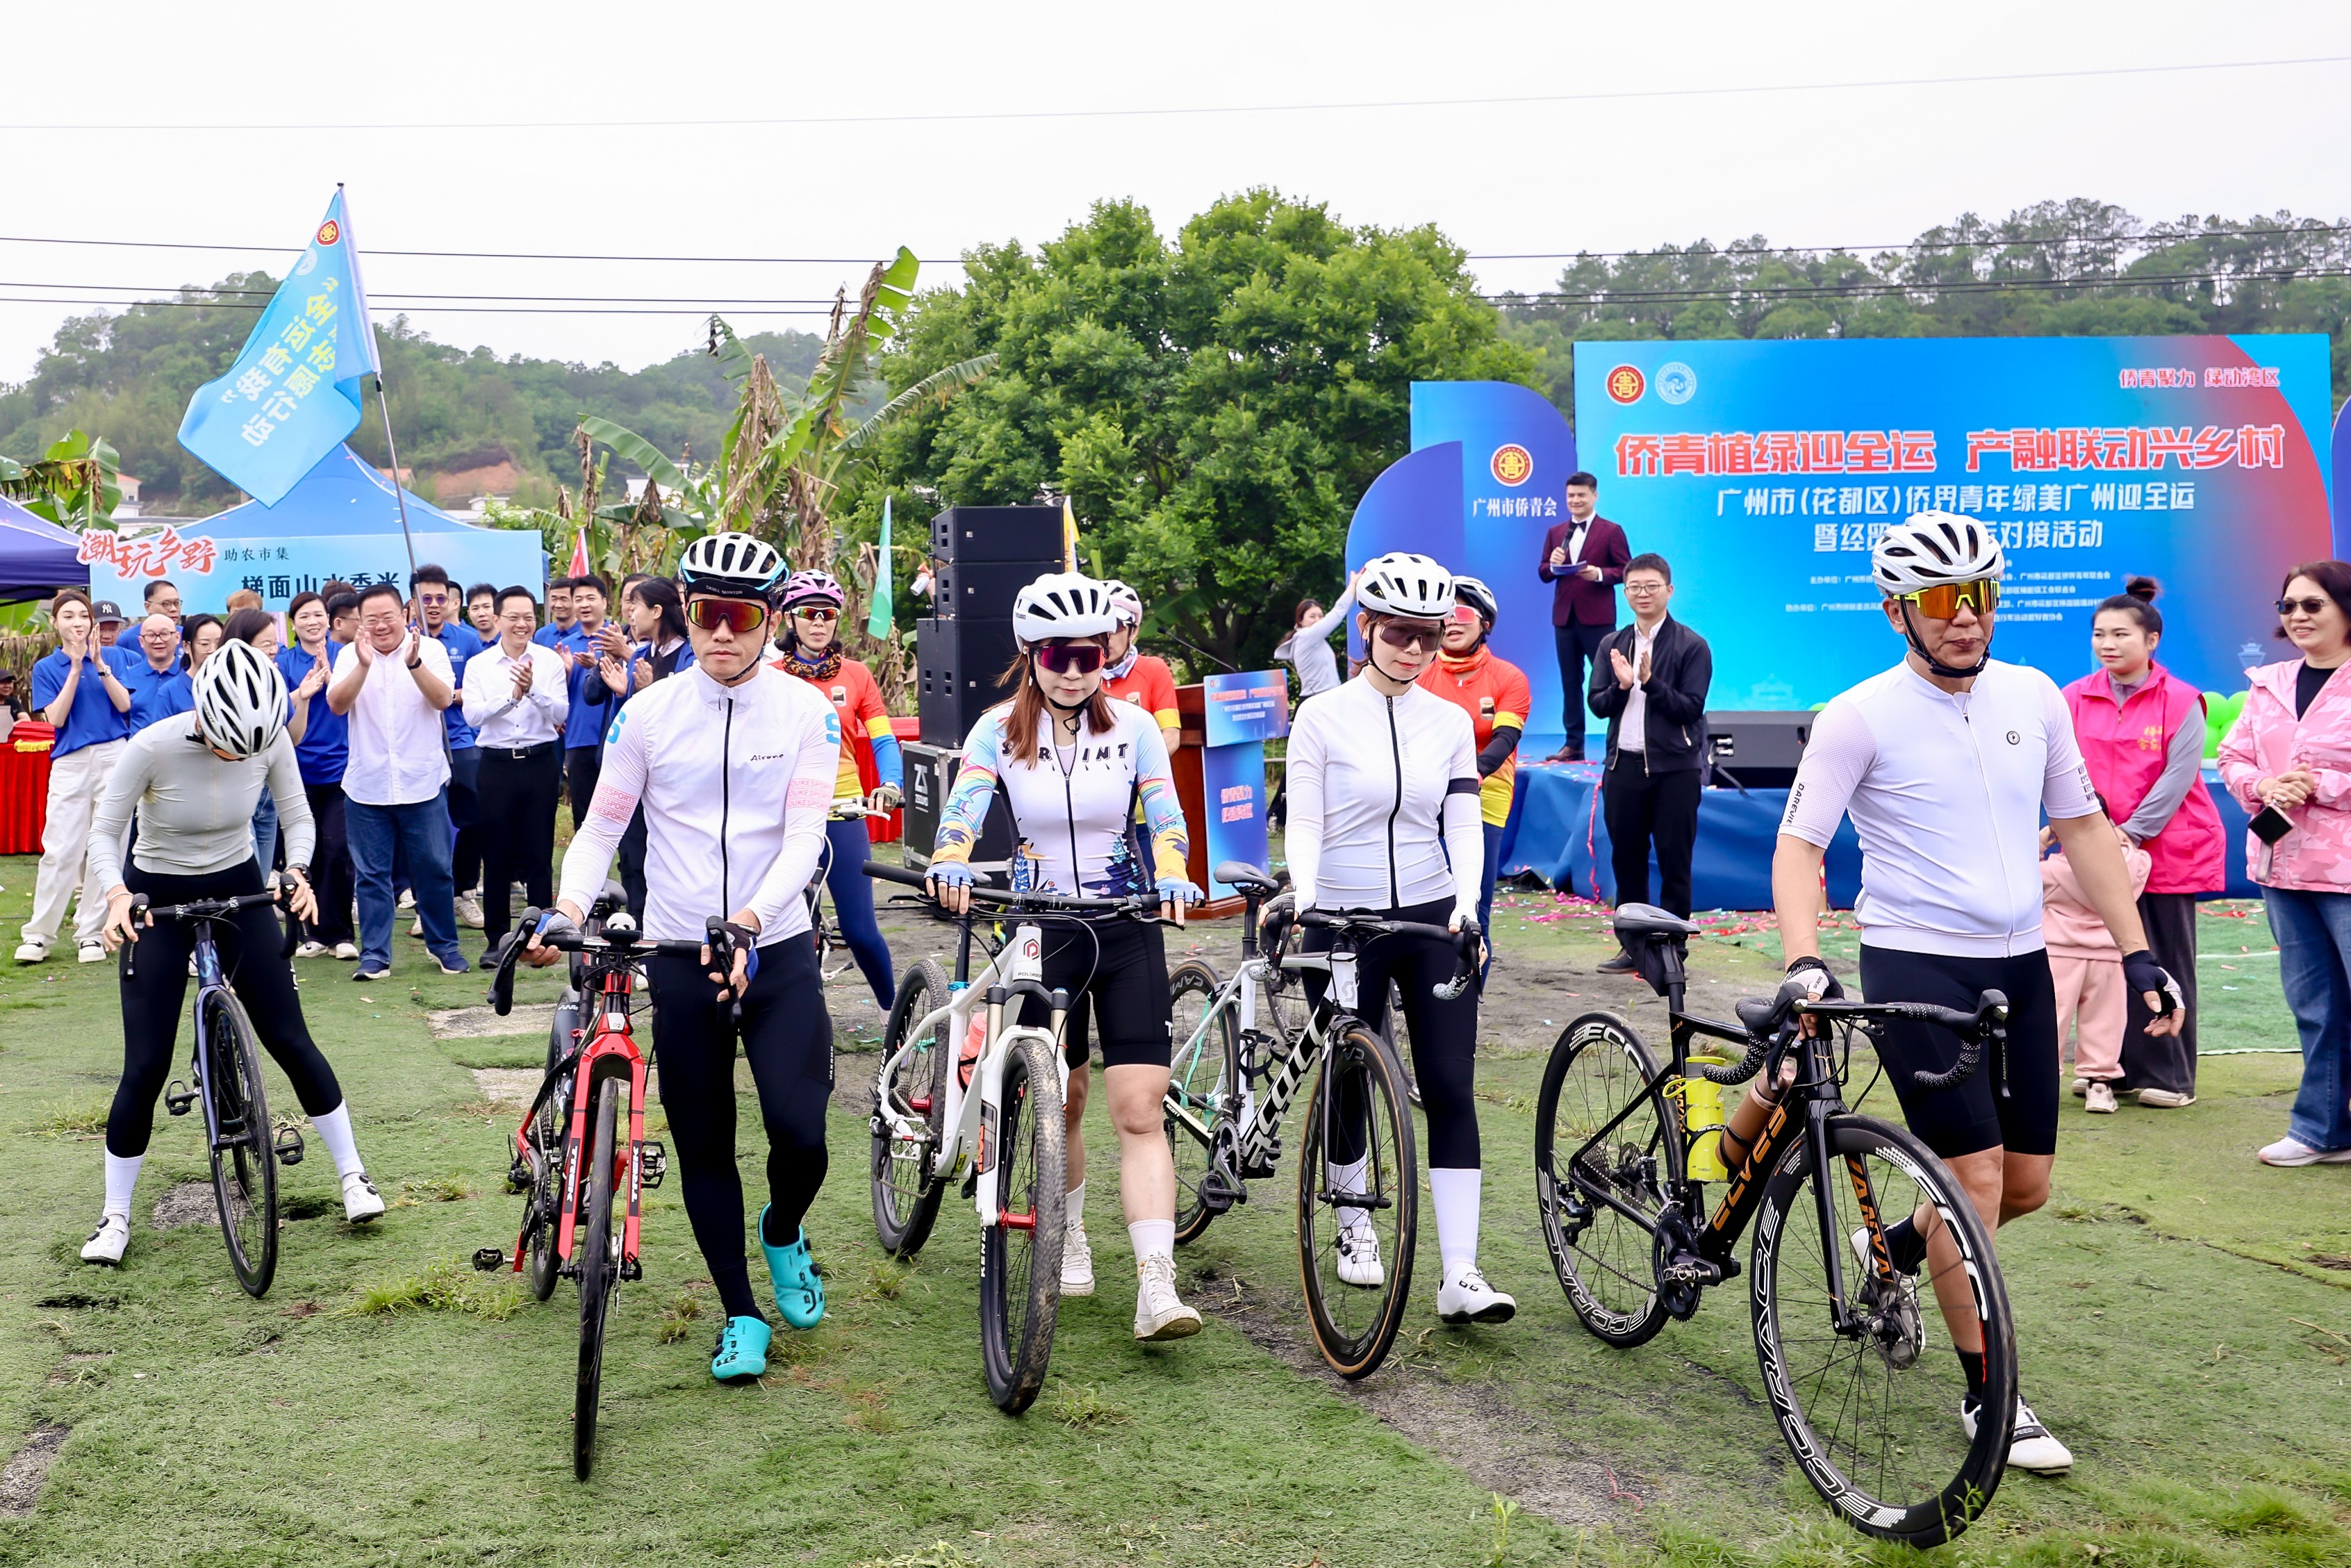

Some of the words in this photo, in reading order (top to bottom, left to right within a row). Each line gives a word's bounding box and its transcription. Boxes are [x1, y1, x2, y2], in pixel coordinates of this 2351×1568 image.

[2120, 369, 2195, 388] 侨青聚力
[2204, 368, 2279, 387] 绿动湾区
[1615, 430, 1937, 477] 侨青植绿迎全运
[1966, 423, 2285, 472] 产融联动兴乡村
[1472, 496, 1557, 517] 广州市侨青会
[80, 526, 217, 579] 潮玩乡野
[224, 546, 290, 561] 助农市集
[750, 753, 784, 761] Airone
[1002, 742, 1129, 764] SRINT
[1171, 975, 1204, 996] CAM
[1242, 1006, 1323, 1169] SCOTT
[1165, 1104, 1180, 1117] SCOTT
[566, 1146, 578, 1203] TREK
[631, 1146, 639, 1203] TREK
[2014, 1426, 2034, 1437] PEED
